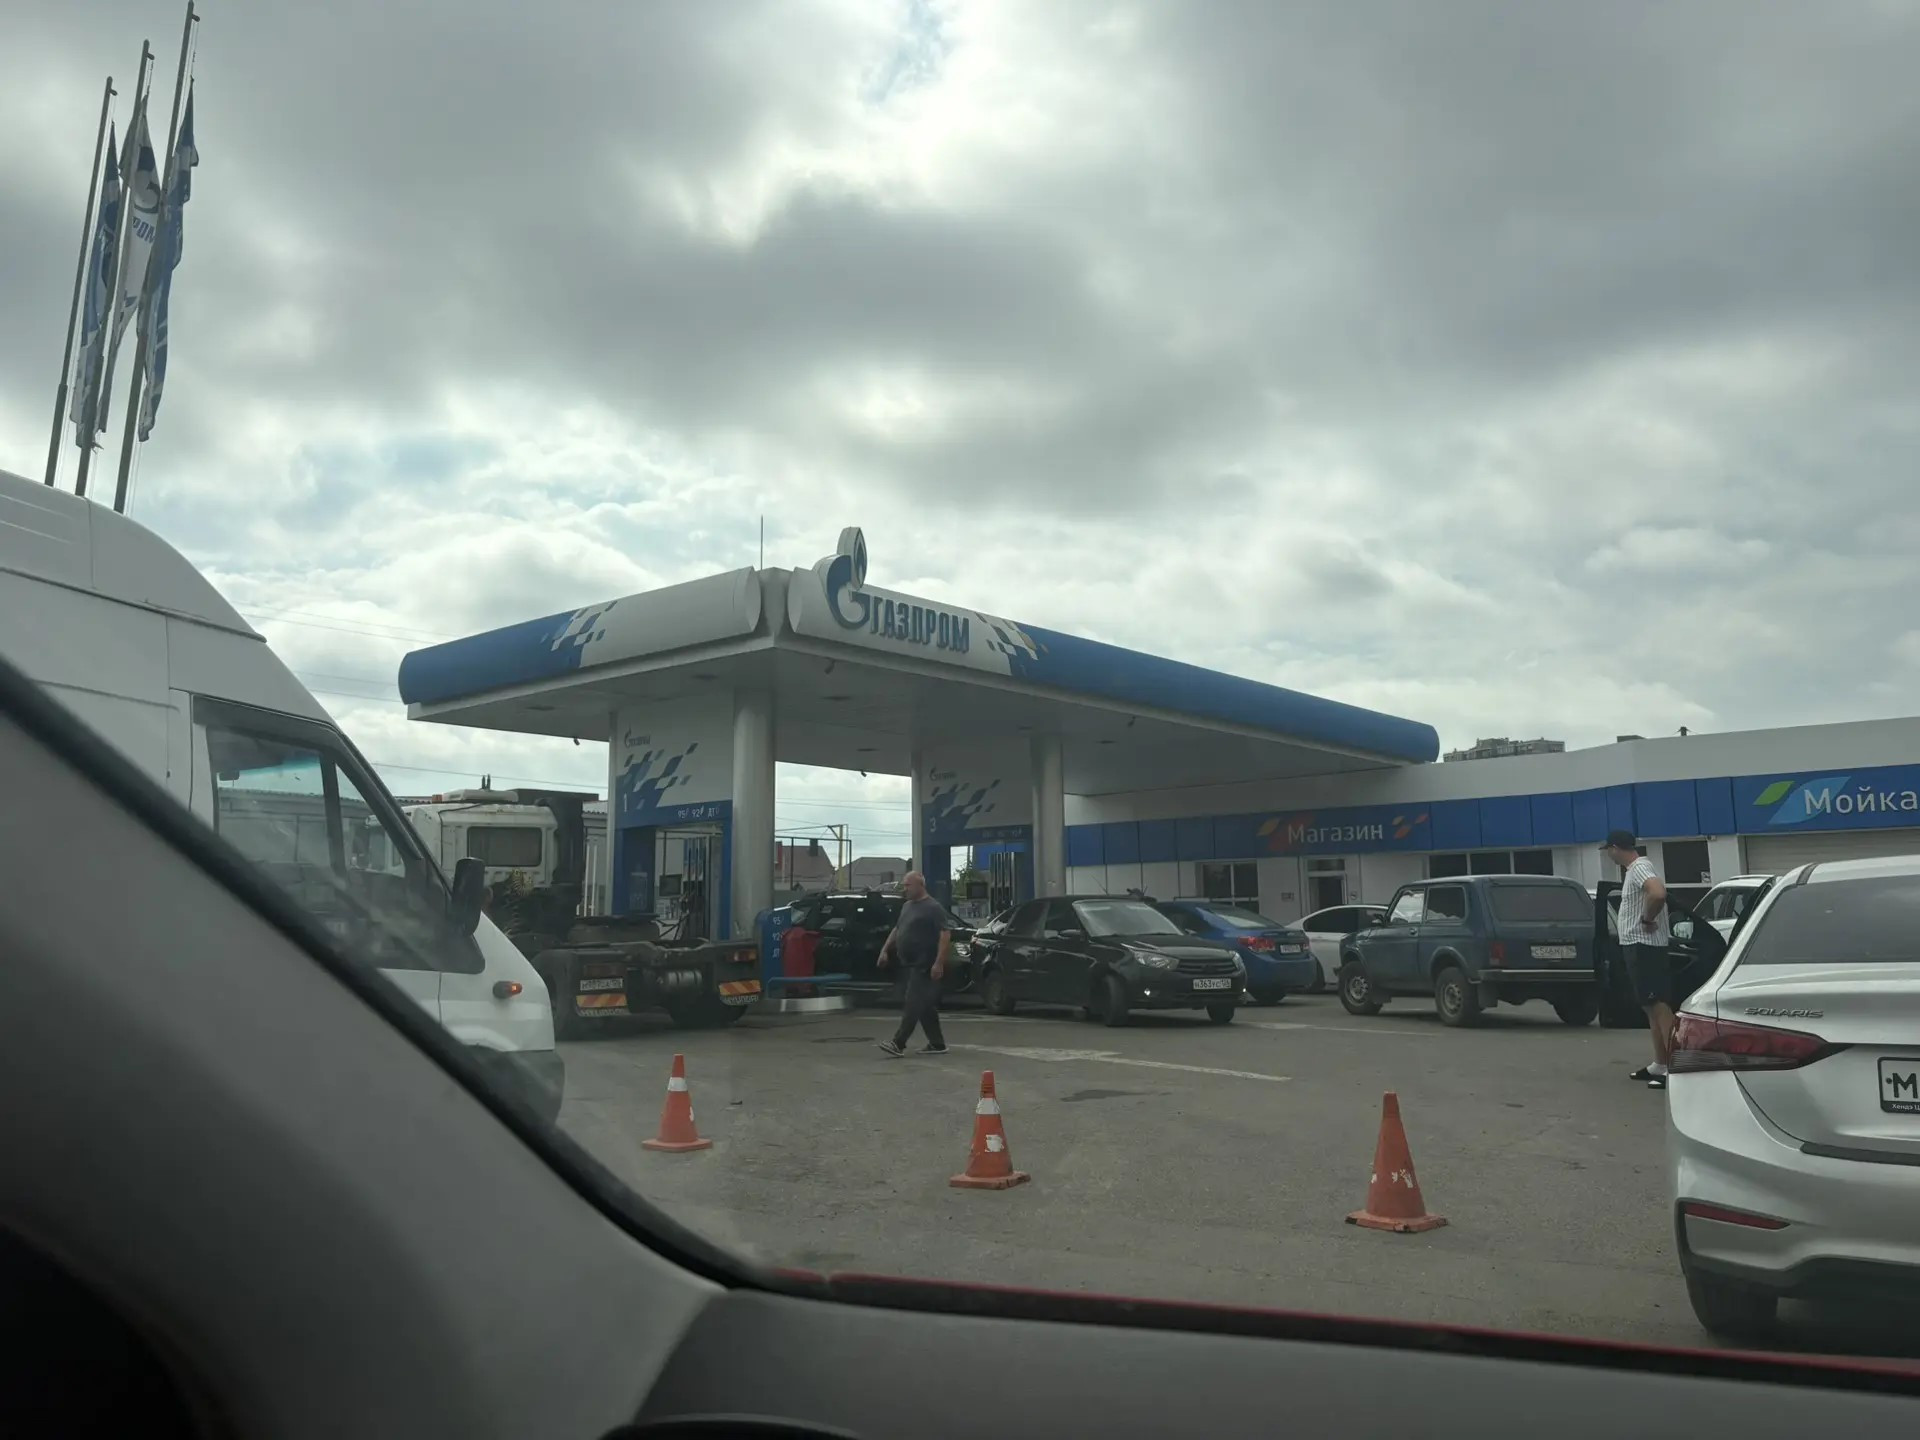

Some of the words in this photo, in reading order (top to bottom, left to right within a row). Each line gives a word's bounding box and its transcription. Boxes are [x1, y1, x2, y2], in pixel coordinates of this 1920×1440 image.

[870, 595, 970, 653] ГАЗПРОМ
[1803, 785, 1919, 815] Мойка
[930, 818, 937, 833] 3
[1287, 823, 1384, 845] Магазин
[1743, 1007, 1824, 1018] SOLARIS
